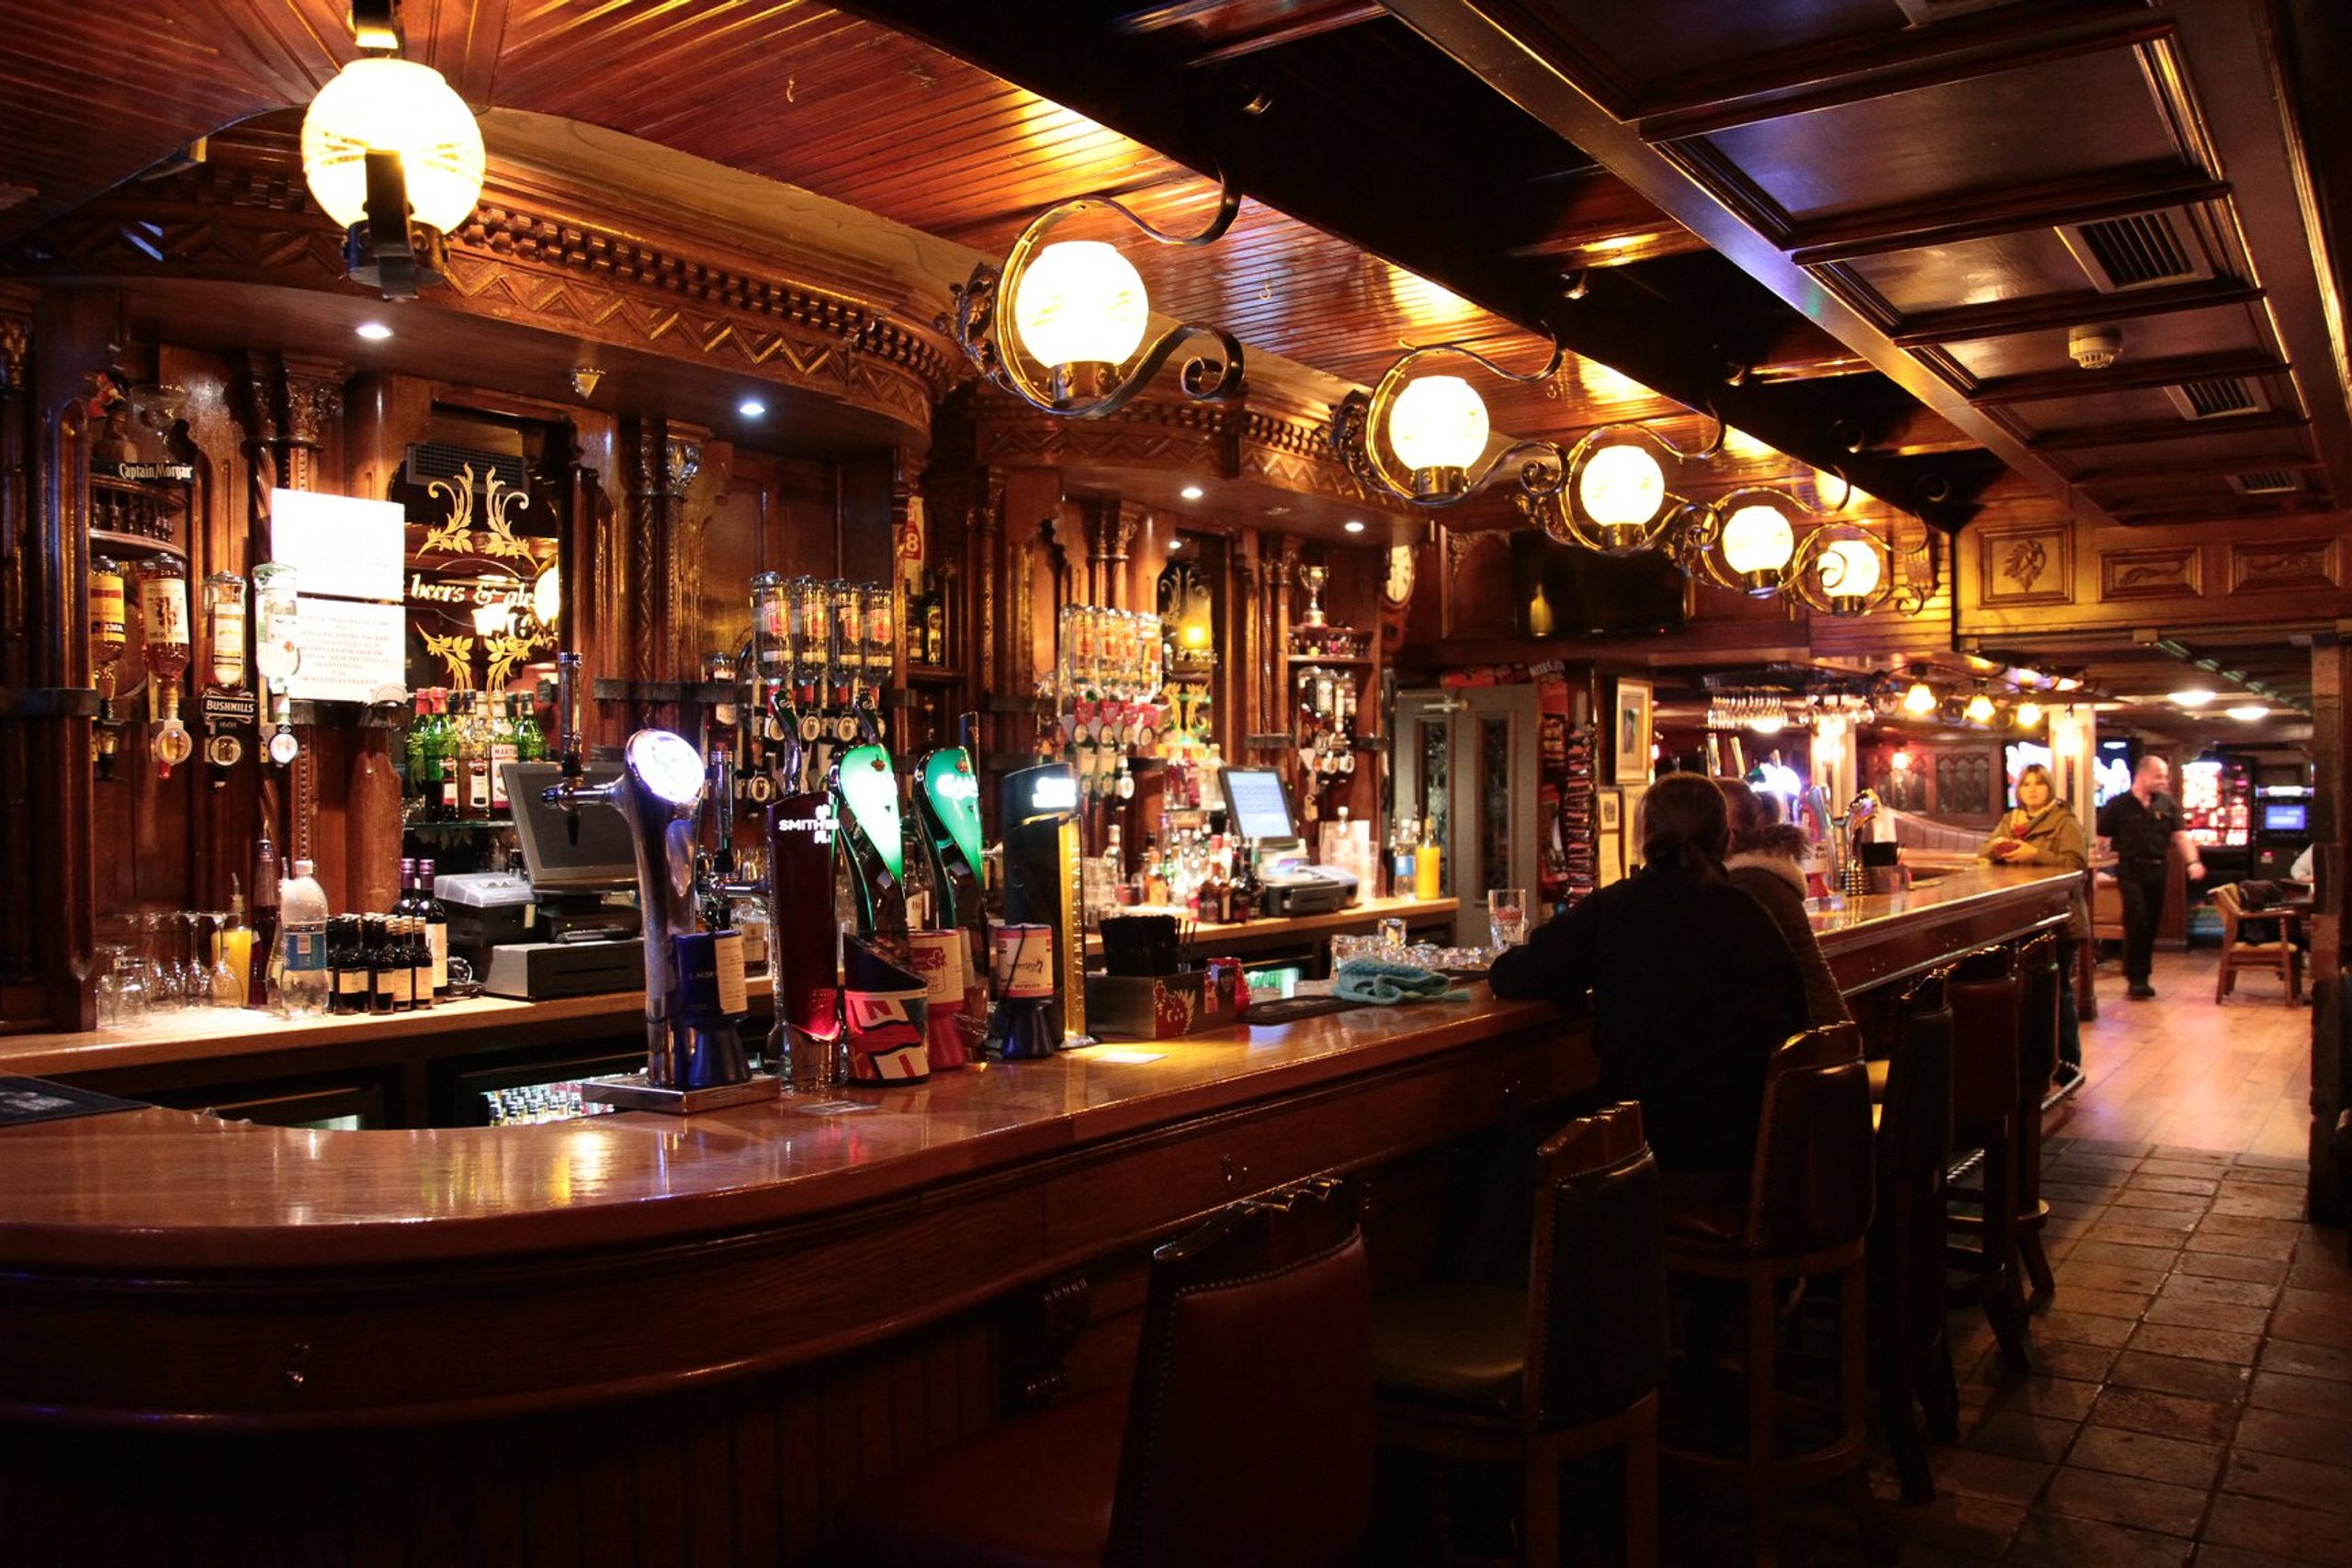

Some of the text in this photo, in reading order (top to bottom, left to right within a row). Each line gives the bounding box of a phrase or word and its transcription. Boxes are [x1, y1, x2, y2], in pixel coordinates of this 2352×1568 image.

[119, 463, 154, 479] Captain
[906, 533, 919, 552] 8
[411, 573, 466, 603] beers
[206, 699, 254, 714] BUSHMILLS
